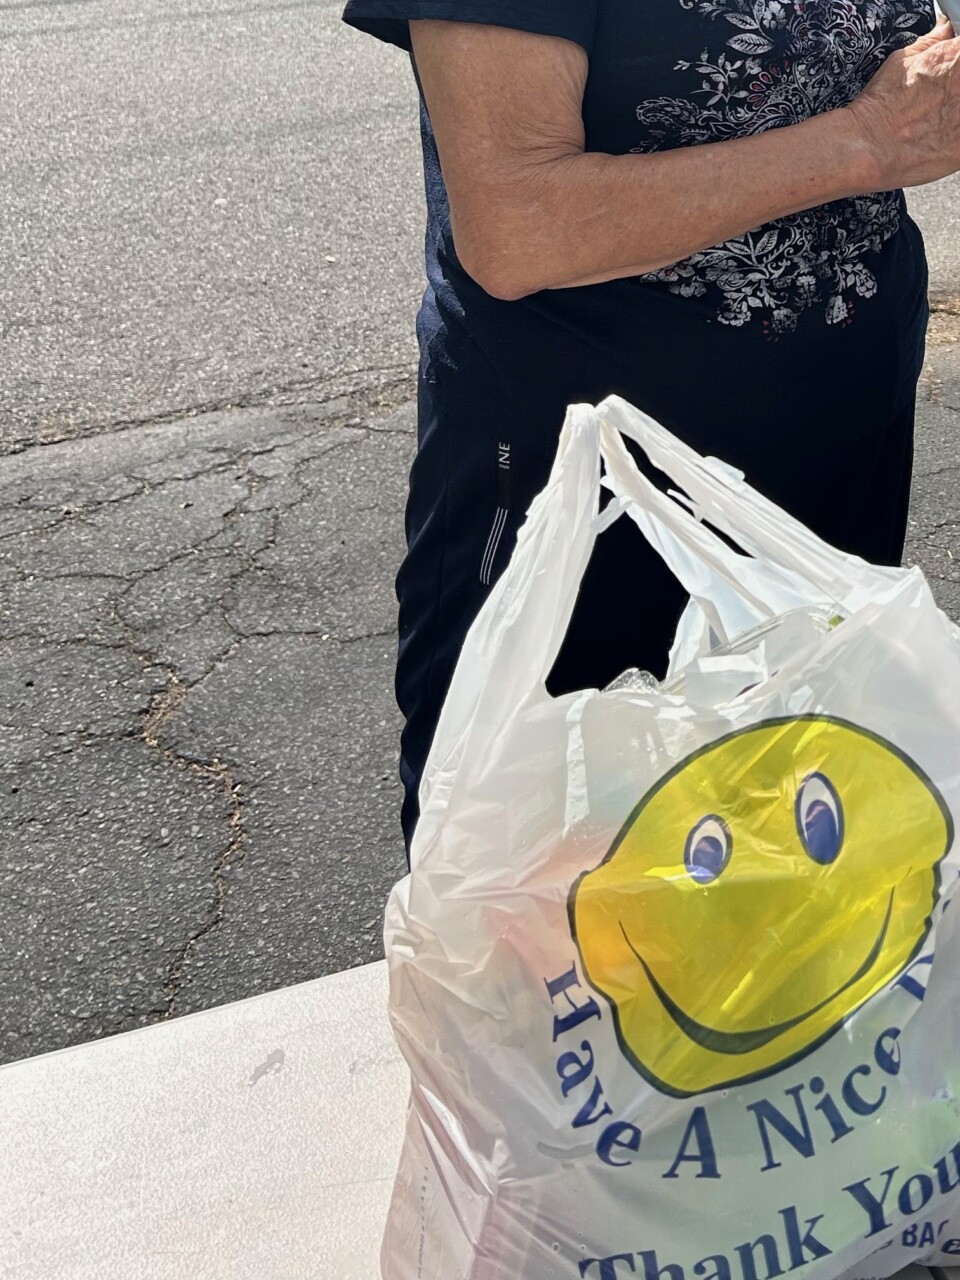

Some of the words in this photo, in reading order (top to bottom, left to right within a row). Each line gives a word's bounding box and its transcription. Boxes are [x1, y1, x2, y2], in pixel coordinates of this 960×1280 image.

[543, 960, 642, 1167] Have
[661, 1106, 722, 1179] A
[746, 1027, 902, 1172] Nice
